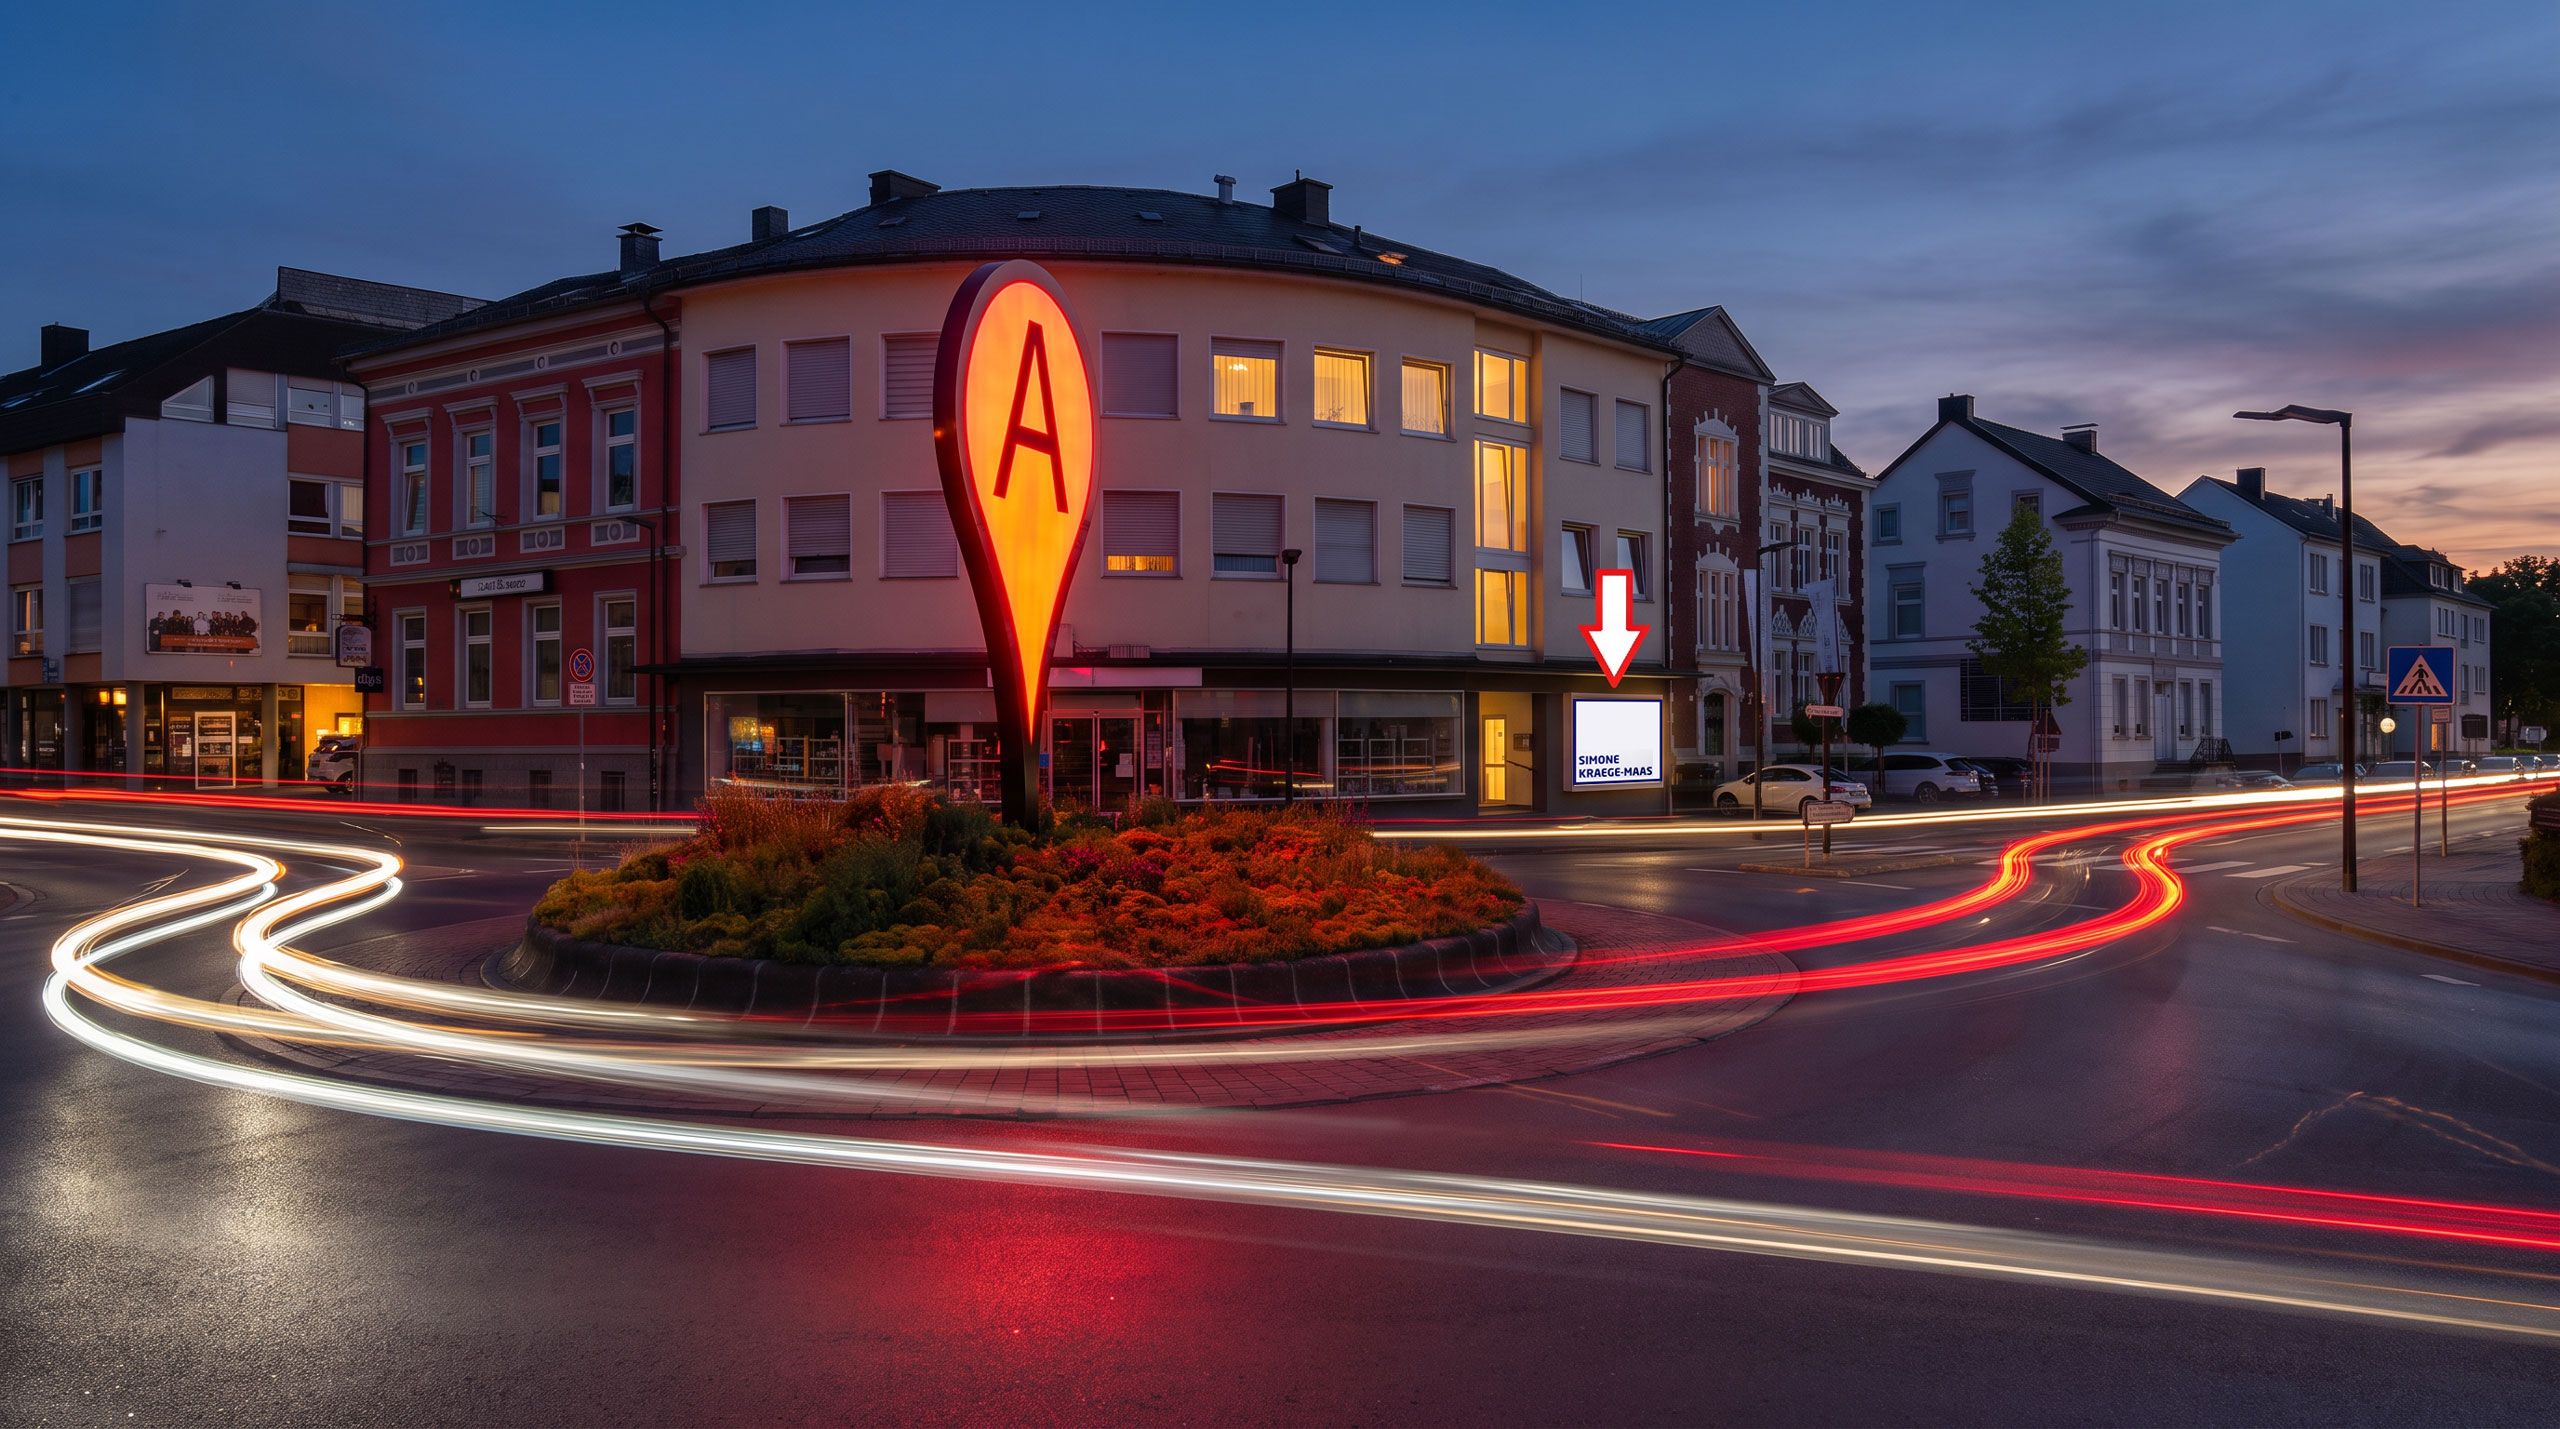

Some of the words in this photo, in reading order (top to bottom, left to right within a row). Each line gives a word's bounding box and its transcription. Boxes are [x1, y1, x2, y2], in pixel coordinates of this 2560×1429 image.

[993, 320, 1069, 514] A
[1578, 755, 1620, 765] SIMONE
[1578, 766, 1653, 778] KRAEGE-MAAS
